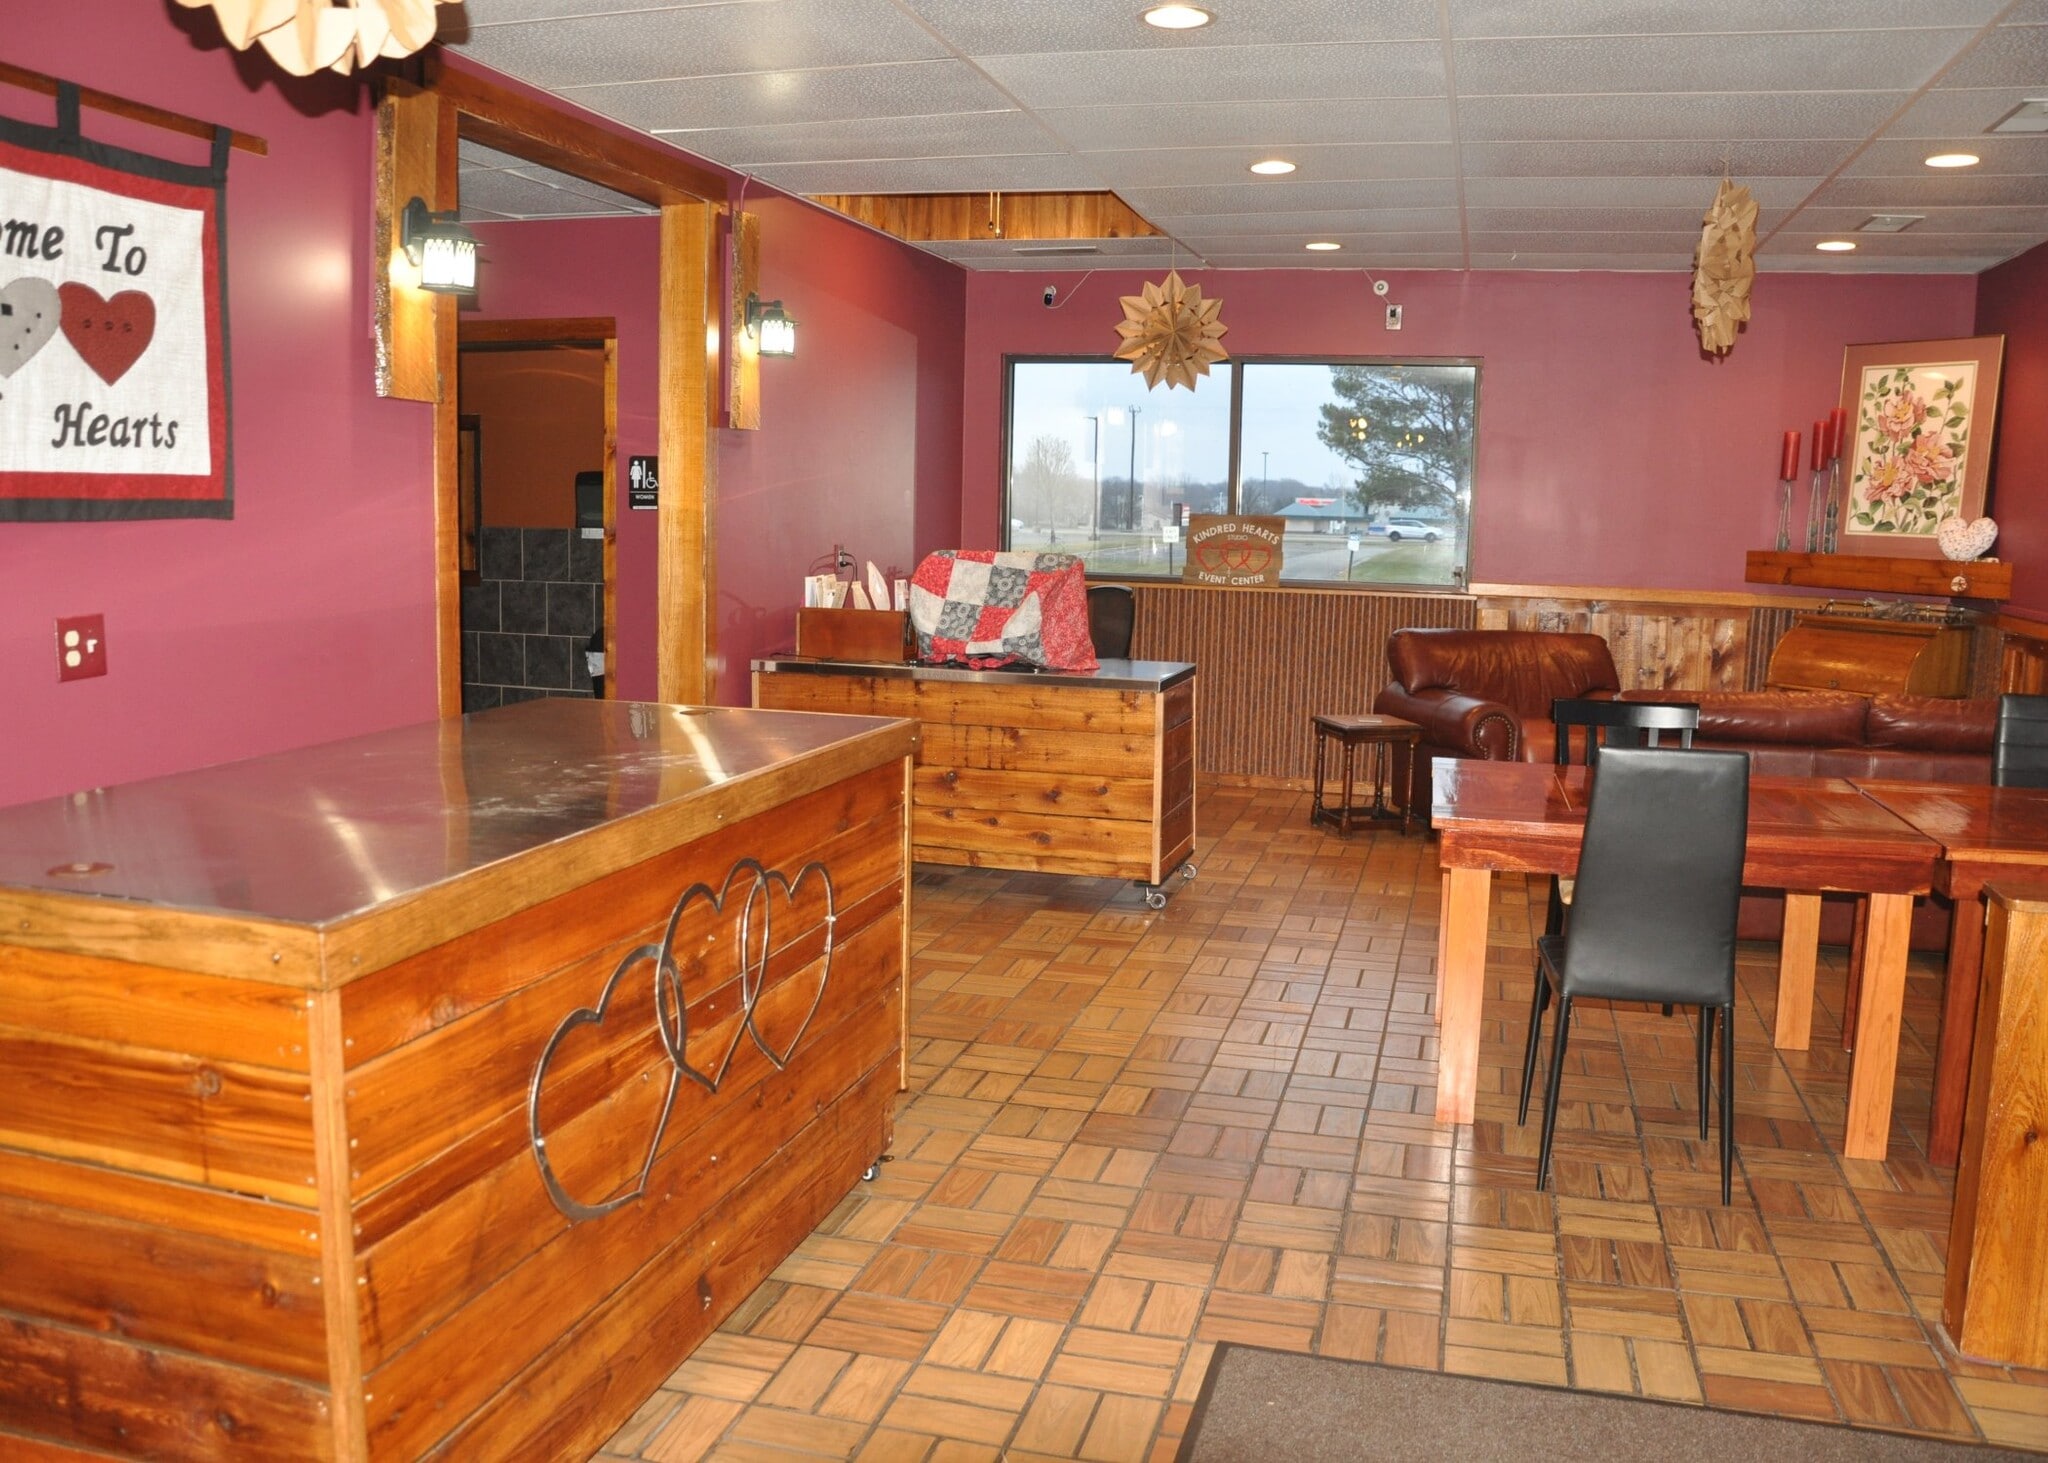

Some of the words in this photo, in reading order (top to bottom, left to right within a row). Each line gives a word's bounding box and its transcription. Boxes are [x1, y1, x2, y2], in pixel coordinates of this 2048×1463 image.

[0, 218, 65, 262] me
[95, 223, 148, 276] To
[51, 402, 179, 449] Hearts
[1192, 523, 1237, 544] KINDRED
[1242, 523, 1280, 545] HEARTS
[1198, 571, 1226, 584] EVENT
[1231, 574, 1265, 586] CENTER
